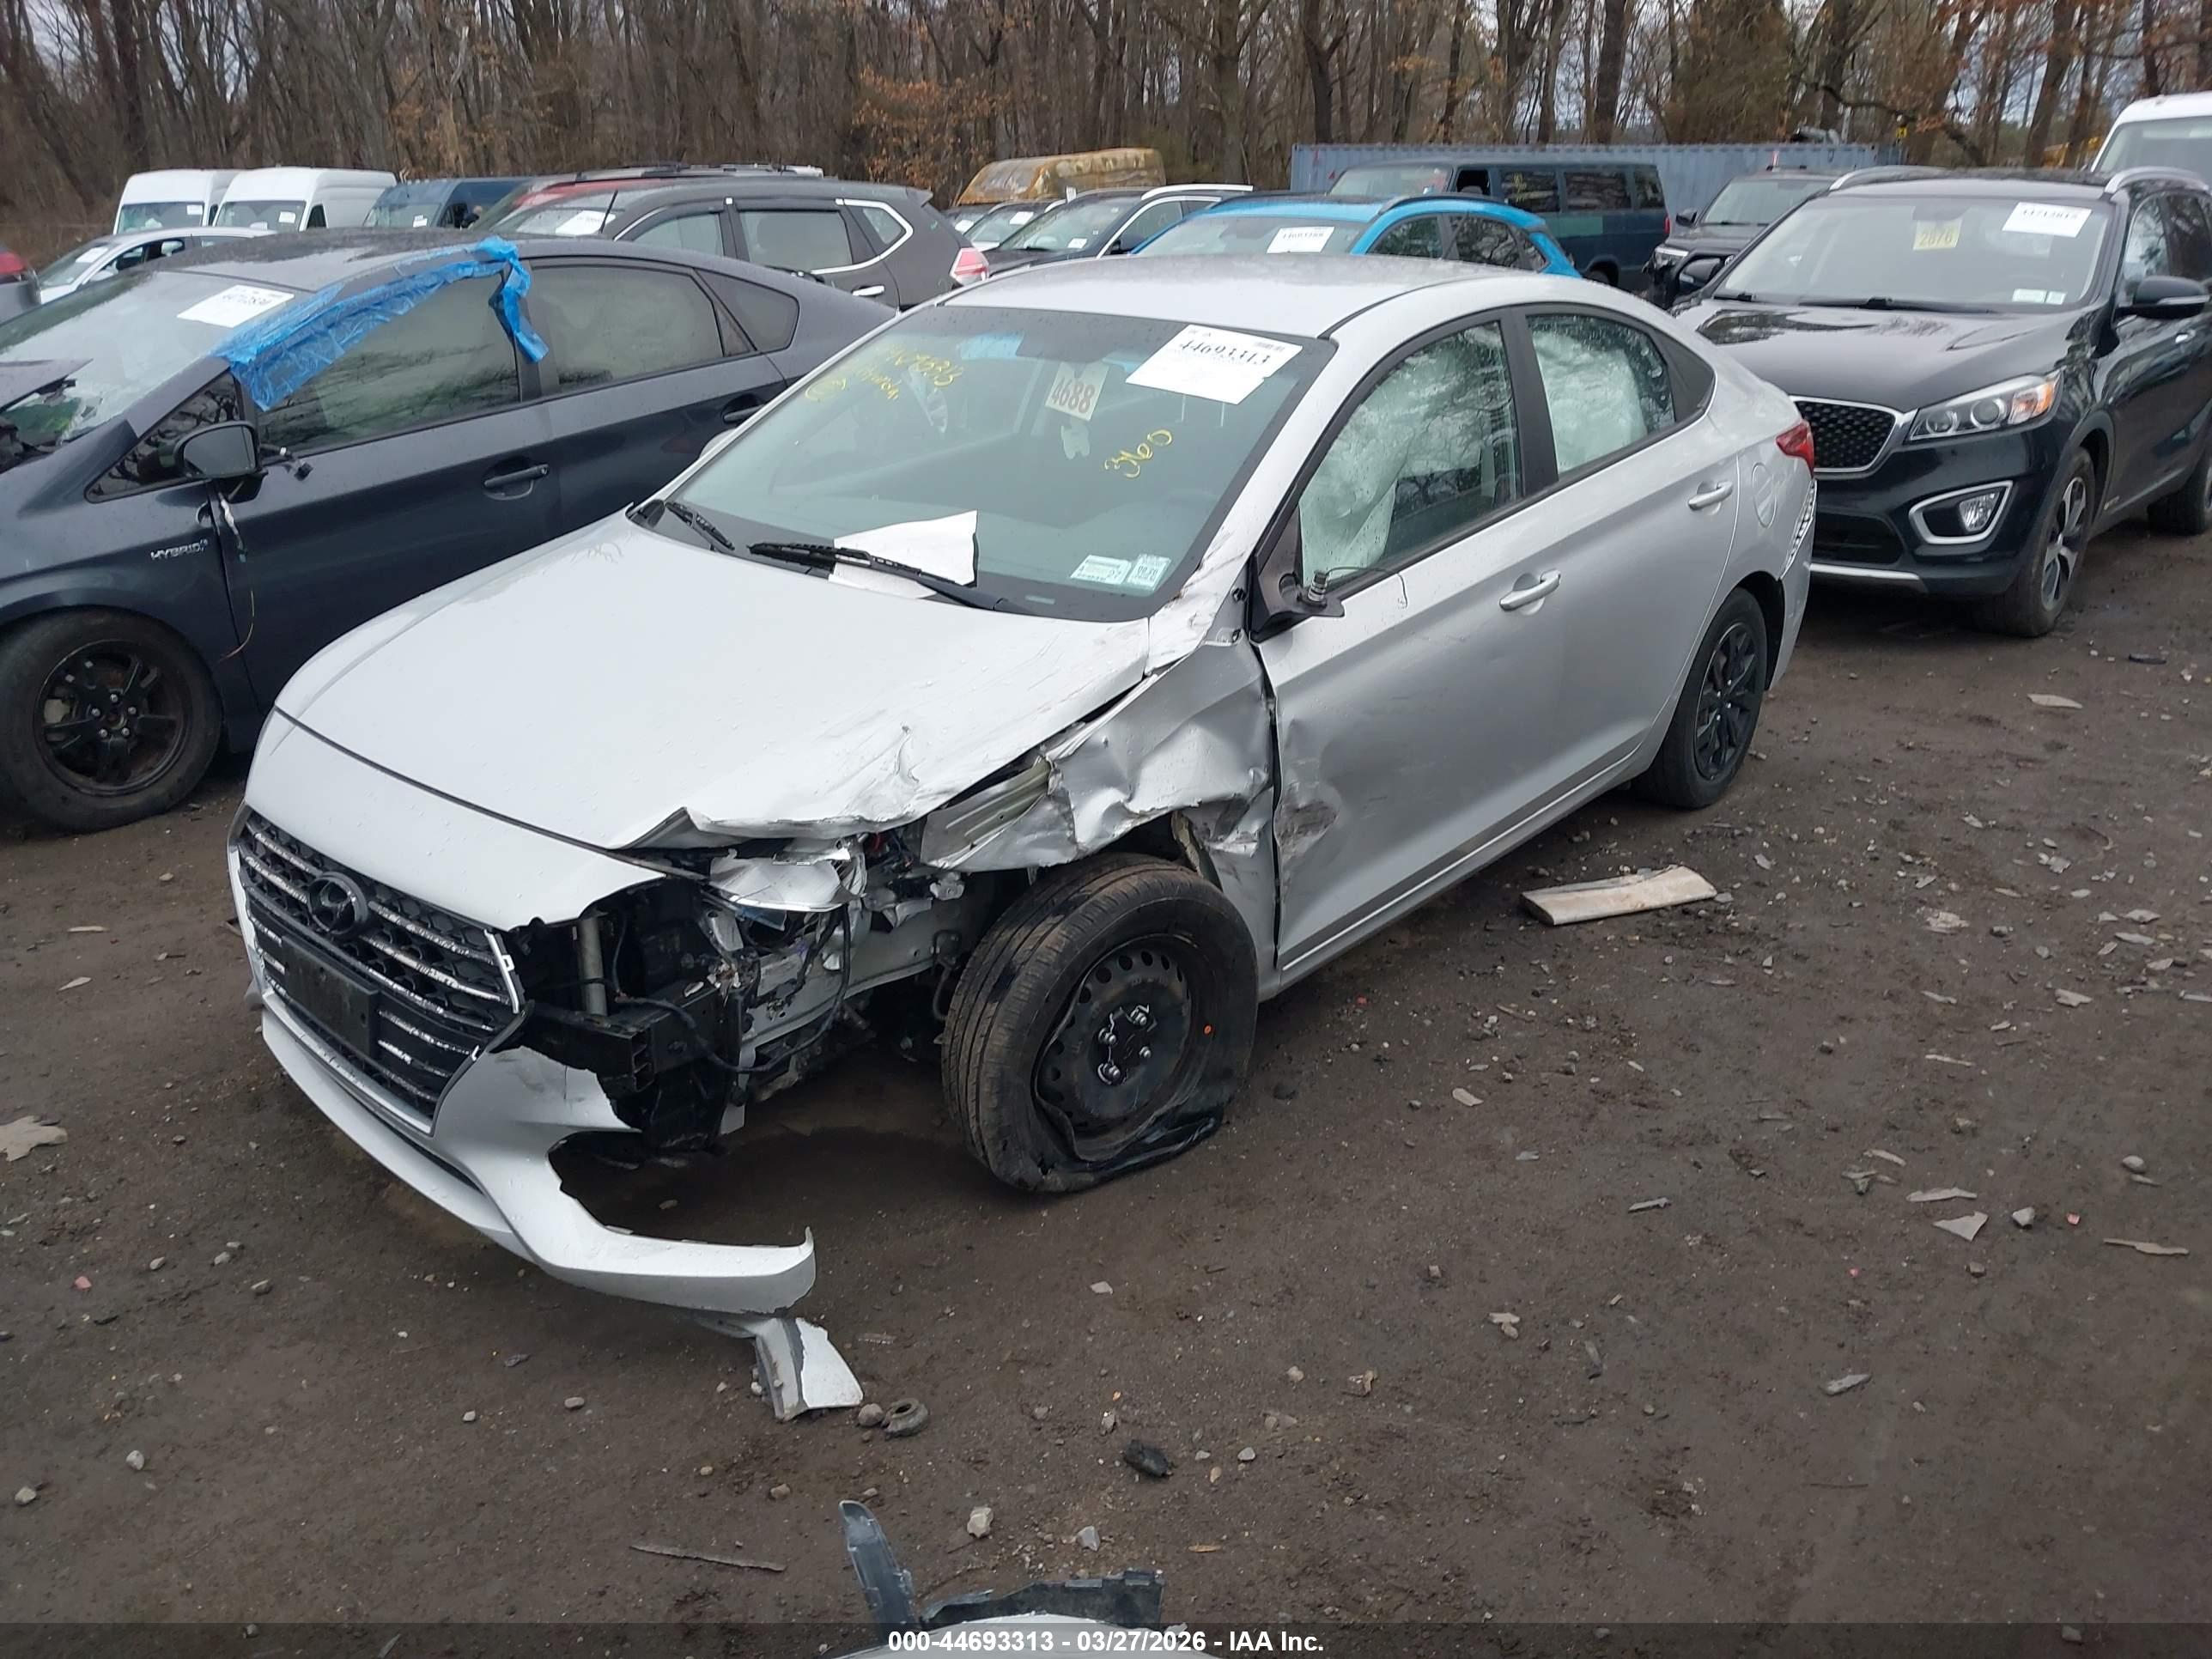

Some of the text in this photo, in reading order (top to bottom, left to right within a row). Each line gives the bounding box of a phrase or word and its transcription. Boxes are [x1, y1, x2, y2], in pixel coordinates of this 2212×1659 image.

[1180, 339, 1271, 365] 44693313
[1051, 378, 1096, 413] 4688
[1104, 428, 1172, 477] 360
[150, 541, 201, 561] HYBRID
